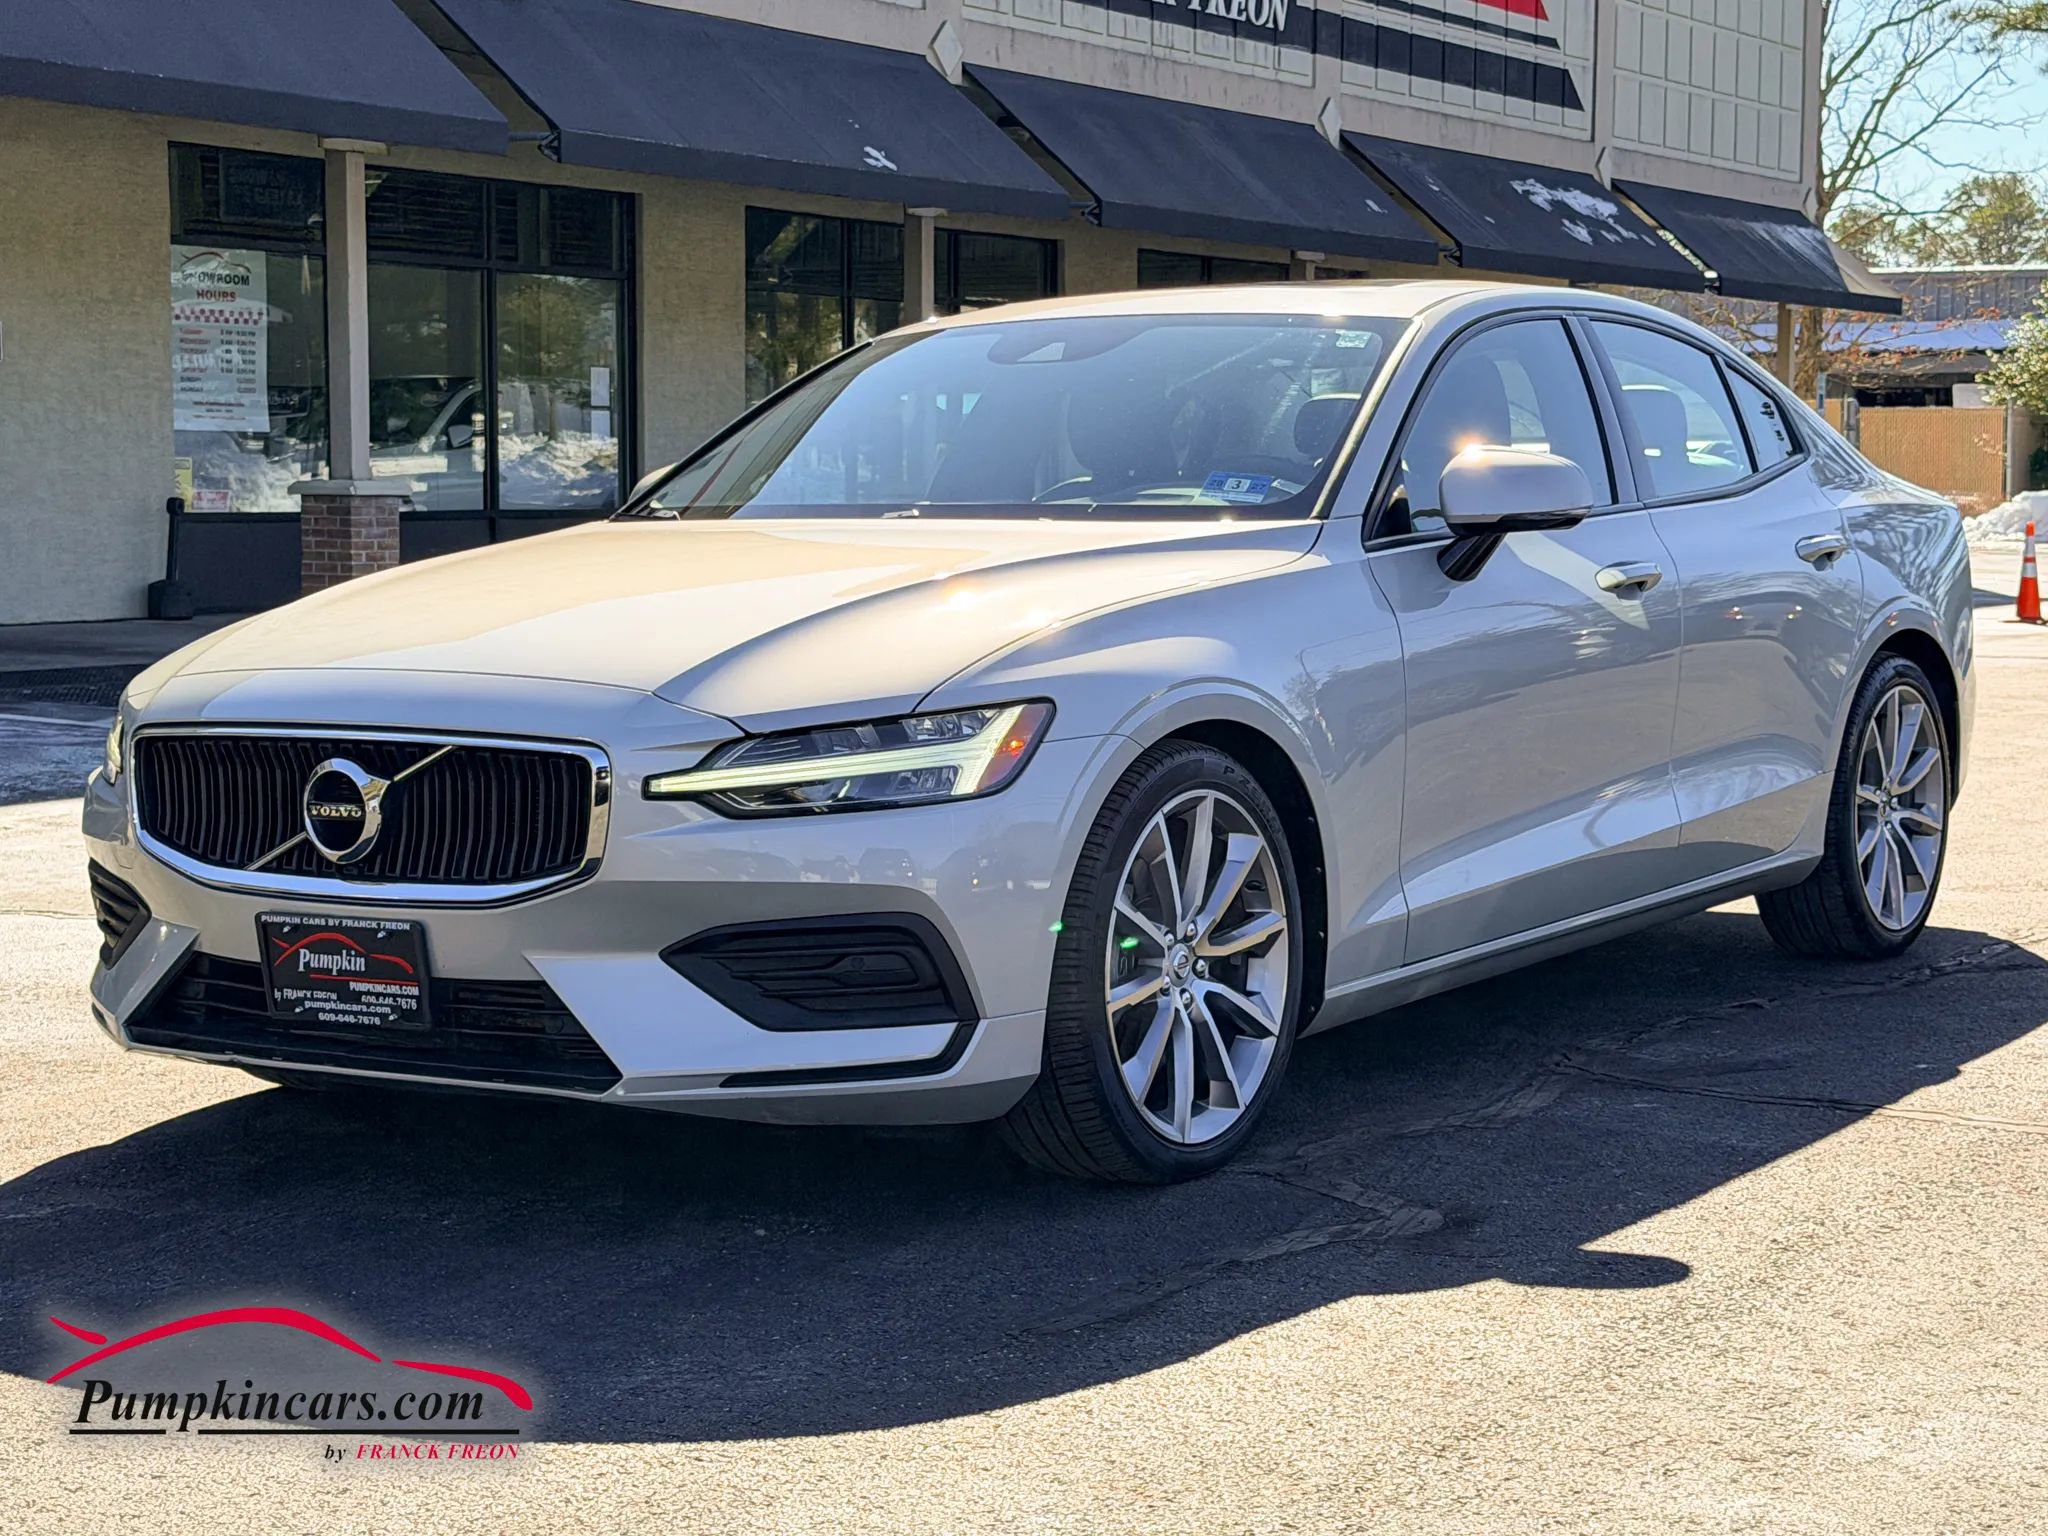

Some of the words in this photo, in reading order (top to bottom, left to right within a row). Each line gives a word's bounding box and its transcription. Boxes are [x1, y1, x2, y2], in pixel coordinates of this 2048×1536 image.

[196, 289, 237, 303] HOURS
[1231, 480, 1242, 489] 3
[311, 805, 362, 817] VOLVO
[261, 914, 301, 925] PUMPKIN
[302, 917, 327, 927] CARS
[328, 918, 340, 928] BY
[342, 919, 379, 929] FRANCK
[380, 921, 411, 931] FREON
[298, 948, 366, 976] Pumpkin
[274, 987, 282, 1002] by
[349, 981, 420, 996] PUMPKINCARS.COM
[304, 1000, 392, 1014] pumpkincars.com
[318, 1012, 381, 1025] 609-646-7676
